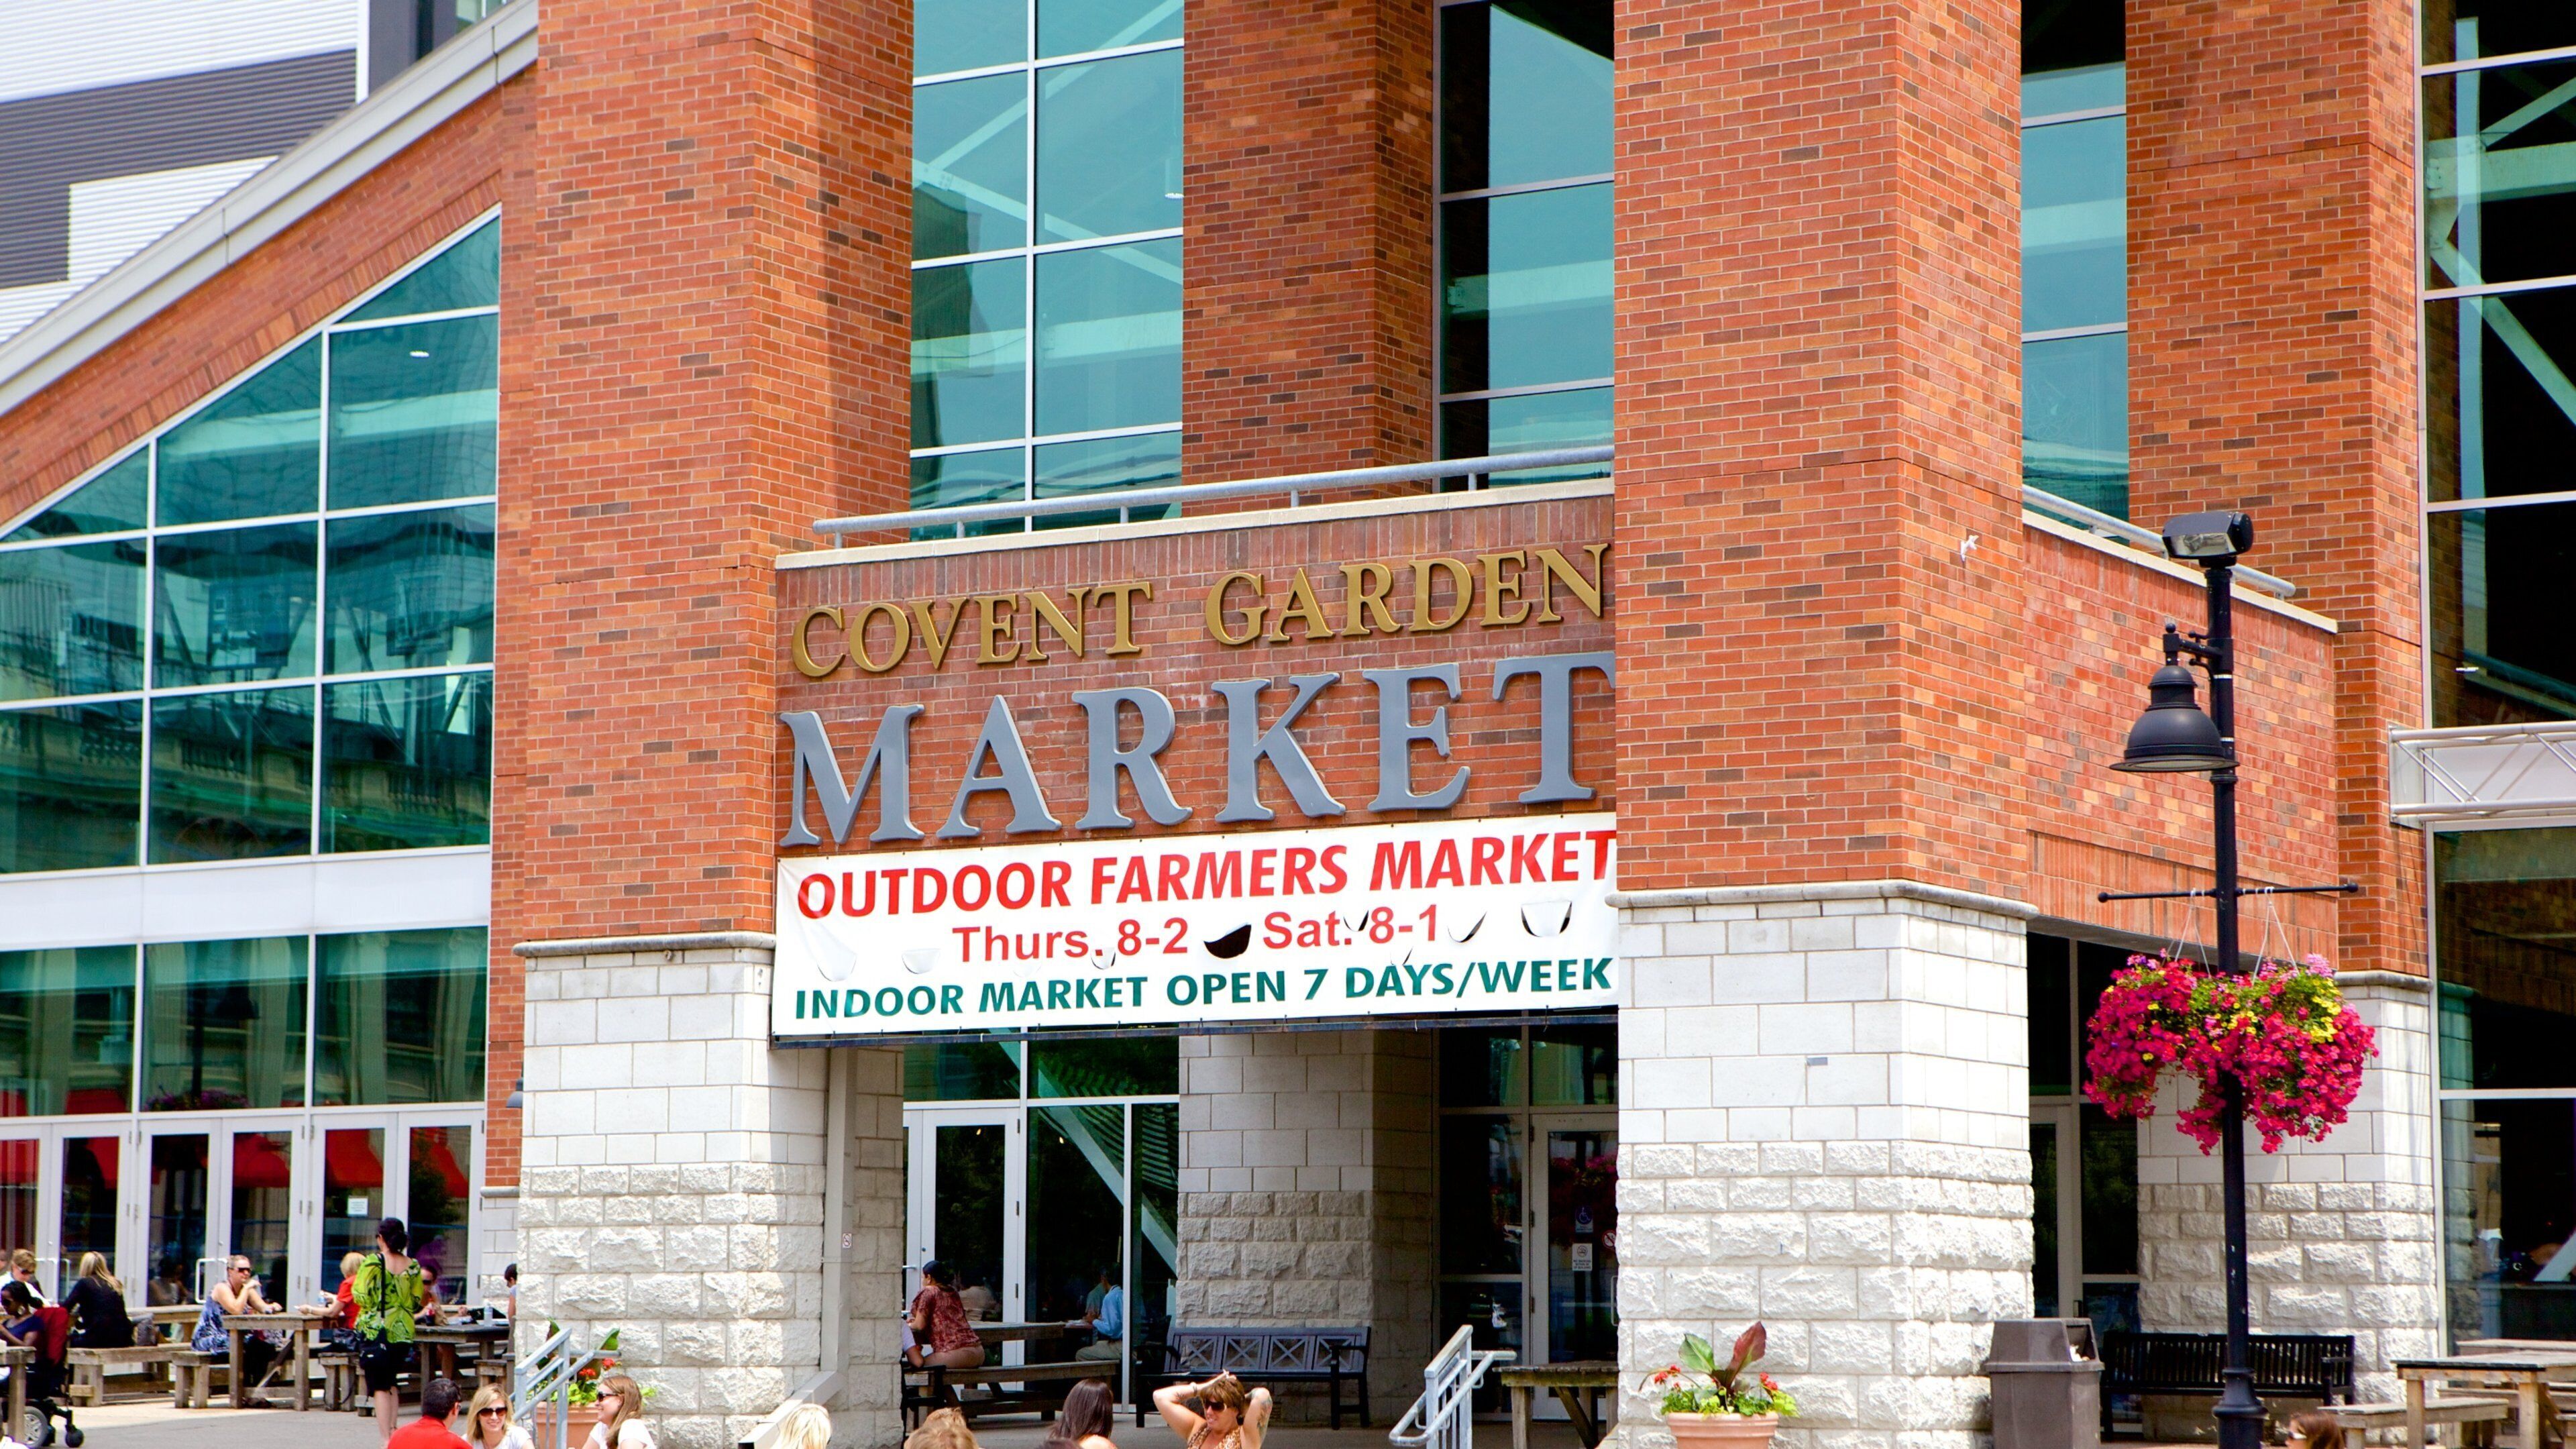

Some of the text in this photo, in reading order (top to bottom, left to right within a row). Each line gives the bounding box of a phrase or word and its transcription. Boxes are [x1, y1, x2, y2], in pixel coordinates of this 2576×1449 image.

[792, 543, 1610, 677] COVENT GARDEN
[779, 651, 1615, 847] MARKET
[798, 830, 1615, 919] OUTDOOR FARMERS MARKET
[953, 905, 1436, 962] Thurs. 8-2 Sat. 8-1
[796, 957, 1612, 1018] INDOOR MARKET OPEN 7 DAYS/WEEK
